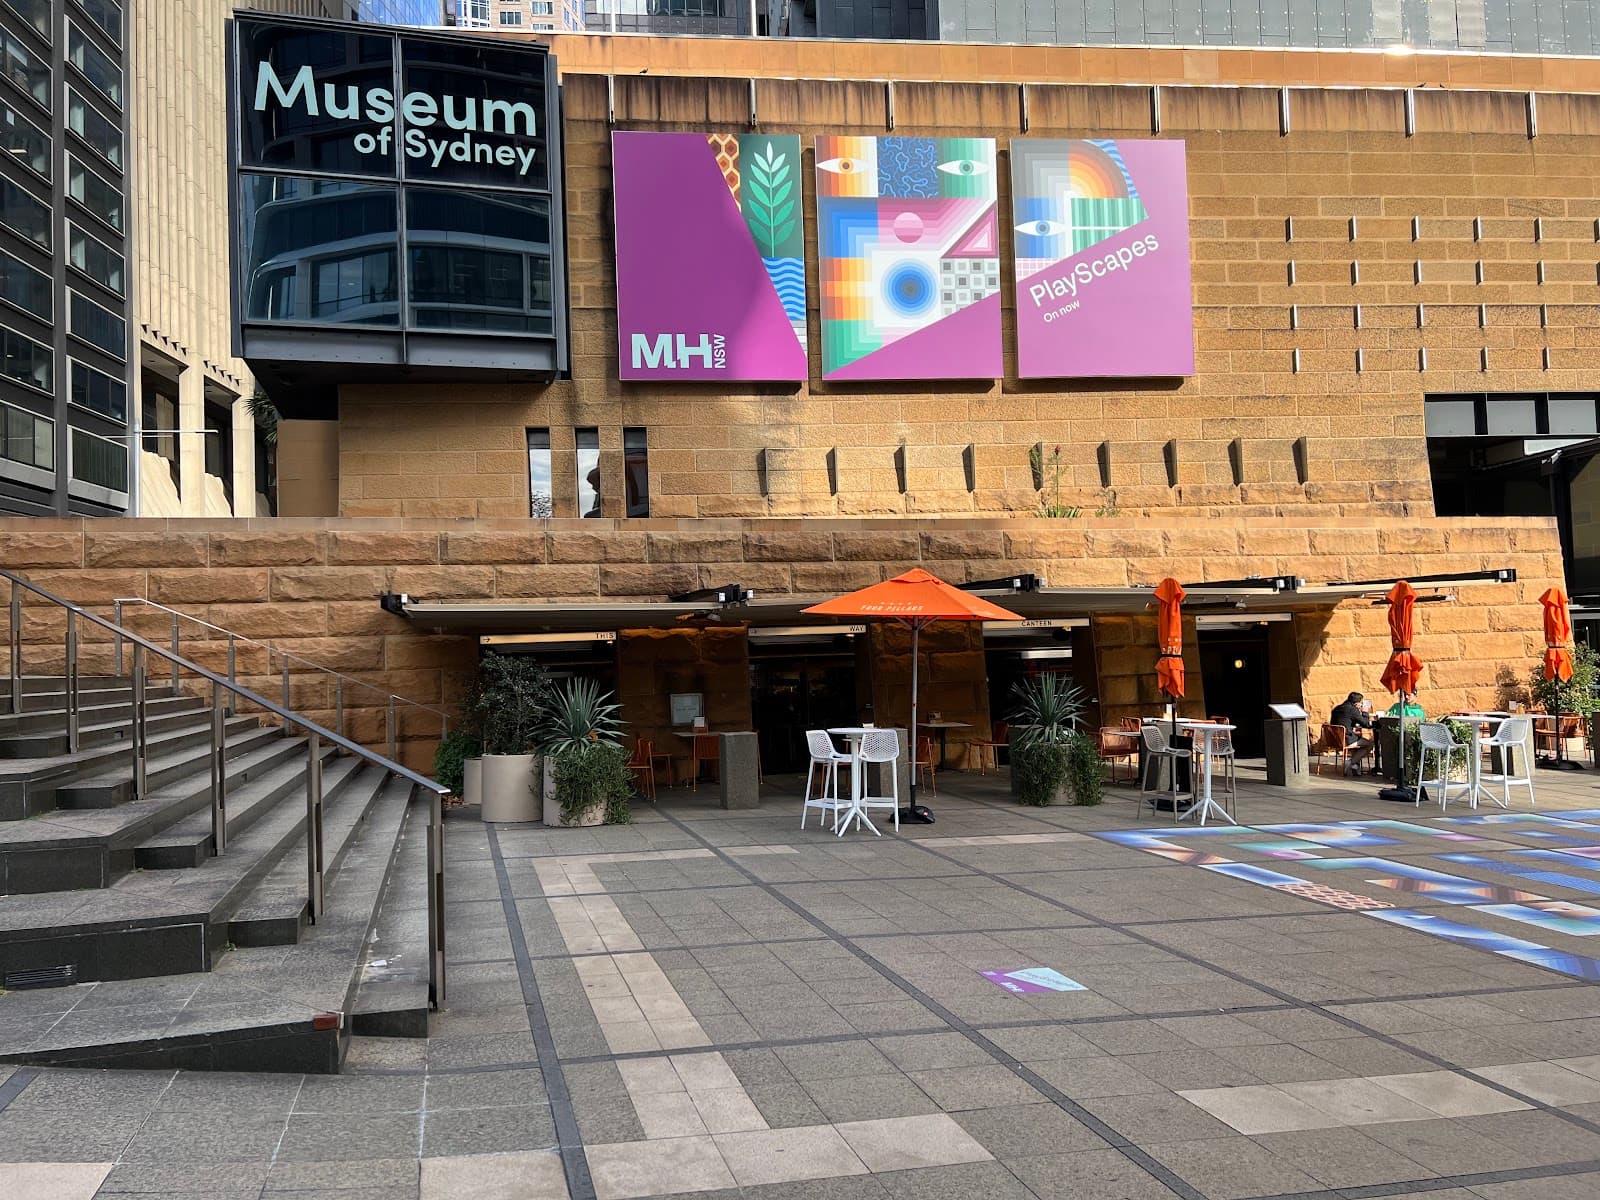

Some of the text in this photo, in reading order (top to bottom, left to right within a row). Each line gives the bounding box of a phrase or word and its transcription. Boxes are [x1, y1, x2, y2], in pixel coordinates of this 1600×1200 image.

[254, 61, 537, 136] Museum
[353, 126, 536, 175] of Sydney
[1029, 234, 1160, 307] PlayScapes
[1043, 300, 1081, 323] On now
[631, 334, 712, 368] MH
[713, 334, 726, 368] NSW
